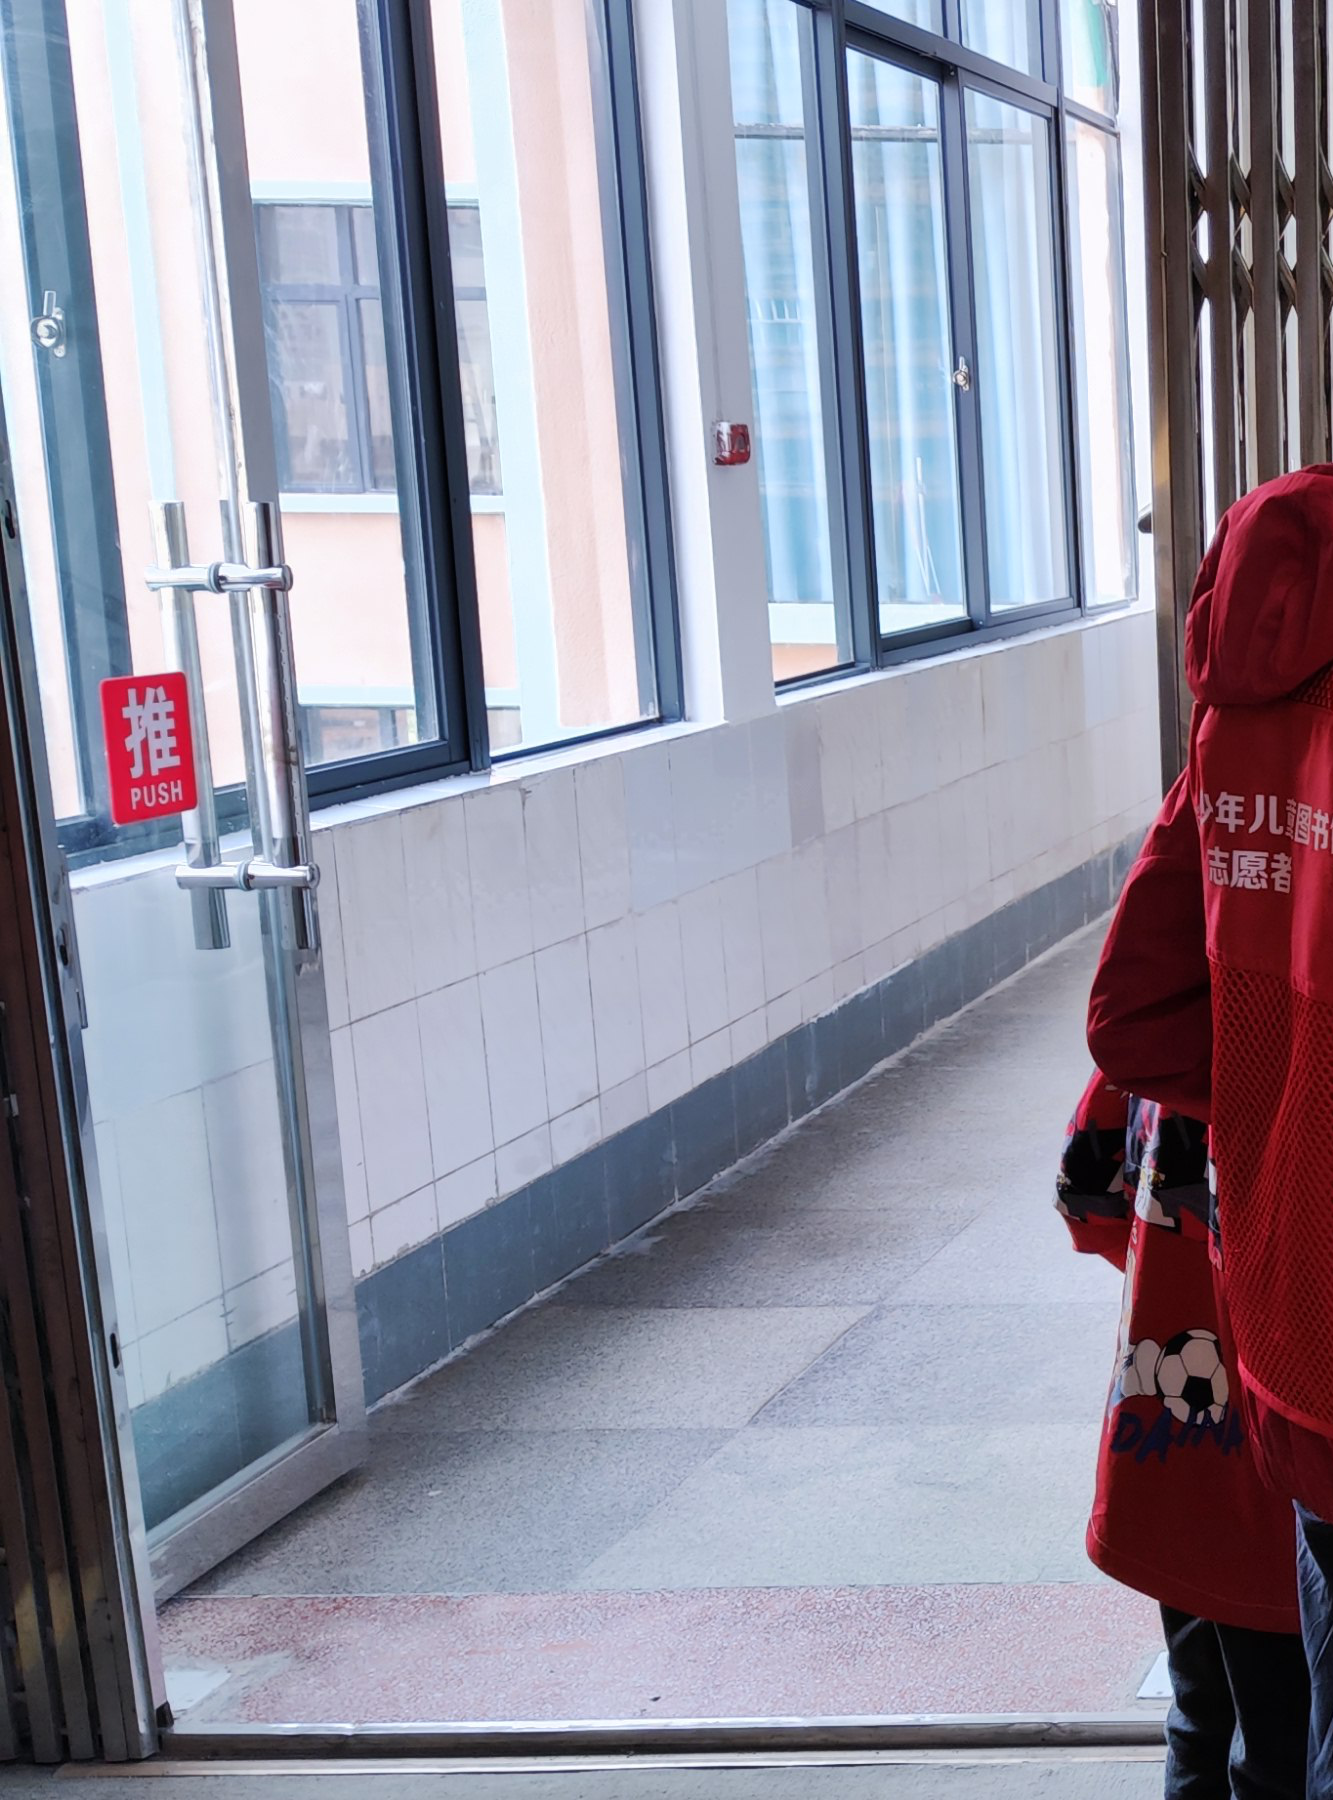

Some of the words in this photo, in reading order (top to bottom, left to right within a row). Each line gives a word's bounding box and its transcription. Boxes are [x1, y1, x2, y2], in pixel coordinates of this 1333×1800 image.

[122, 685, 181, 779] 推
[130, 779, 184, 811] PUSH
[1207, 845, 1292, 894] 志愿者
